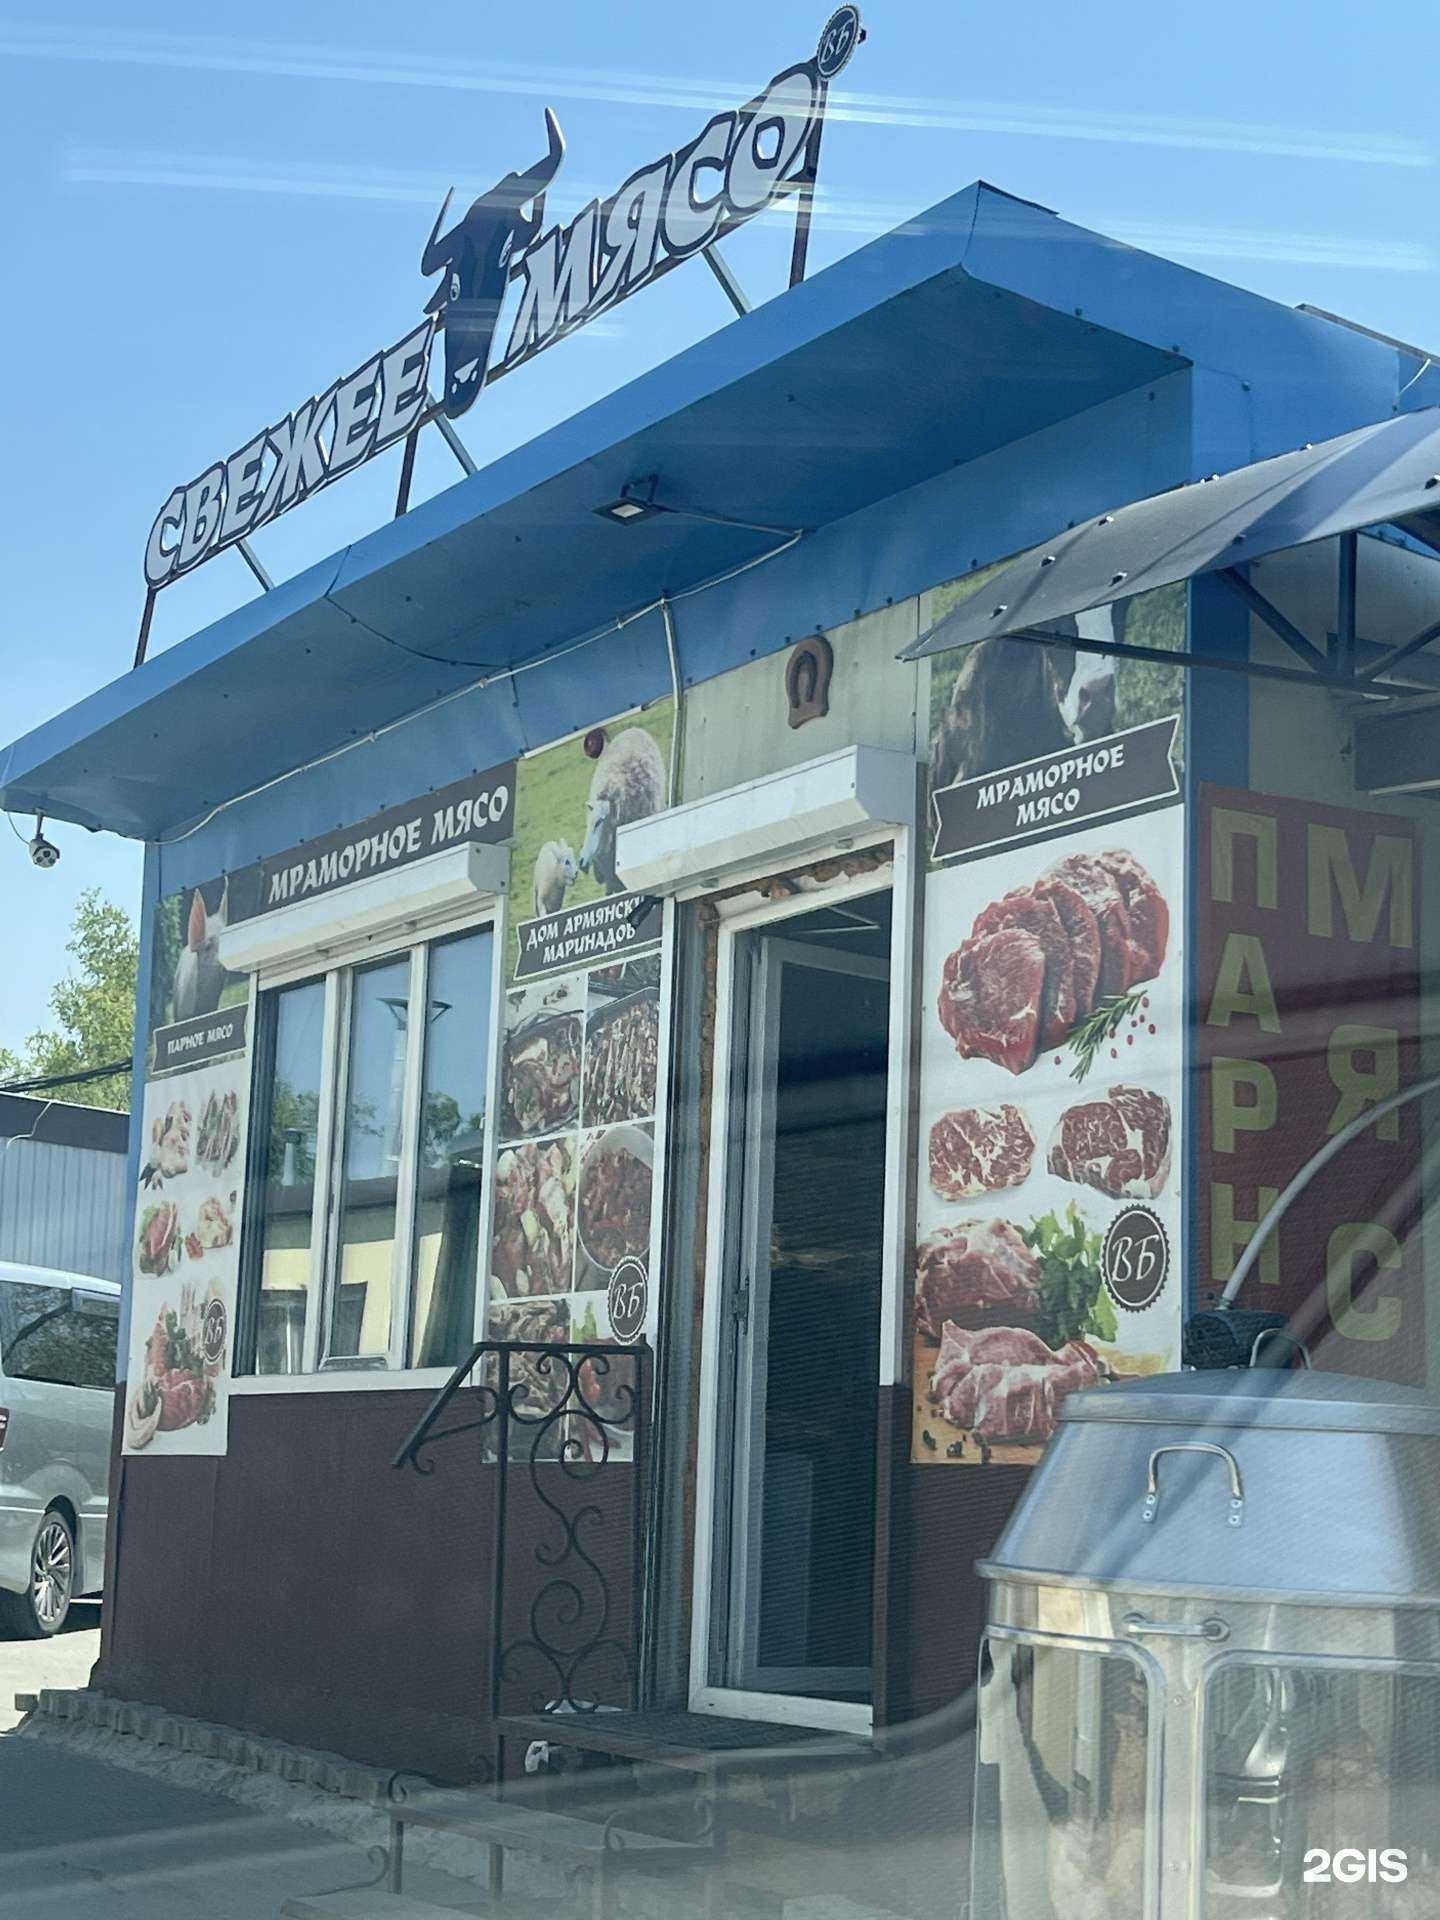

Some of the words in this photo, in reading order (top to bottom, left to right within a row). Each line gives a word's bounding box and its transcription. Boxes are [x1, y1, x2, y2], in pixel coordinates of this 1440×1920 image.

[145, 315, 441, 587] СВЕЖЕЕ
[505, 64, 818, 369] МЯСО
[975, 743, 1125, 810] МРАМОРНОЕ
[1015, 787, 1081, 827] МЯСО
[268, 817, 423, 905] МРАМОРНОЕ
[430, 785, 510, 845] МЯСО
[526, 922, 559, 951] ДОМ
[562, 895, 656, 937] АРМЯНСК
[167, 1031, 205, 1056] ПАРНОЕ
[206, 1023, 234, 1044] МЯСО
[1205, 806, 1281, 1286] ПАРН
[1306, 823, 1413, 1342] МЯС
[1110, 1233, 1160, 1282] ВБ
